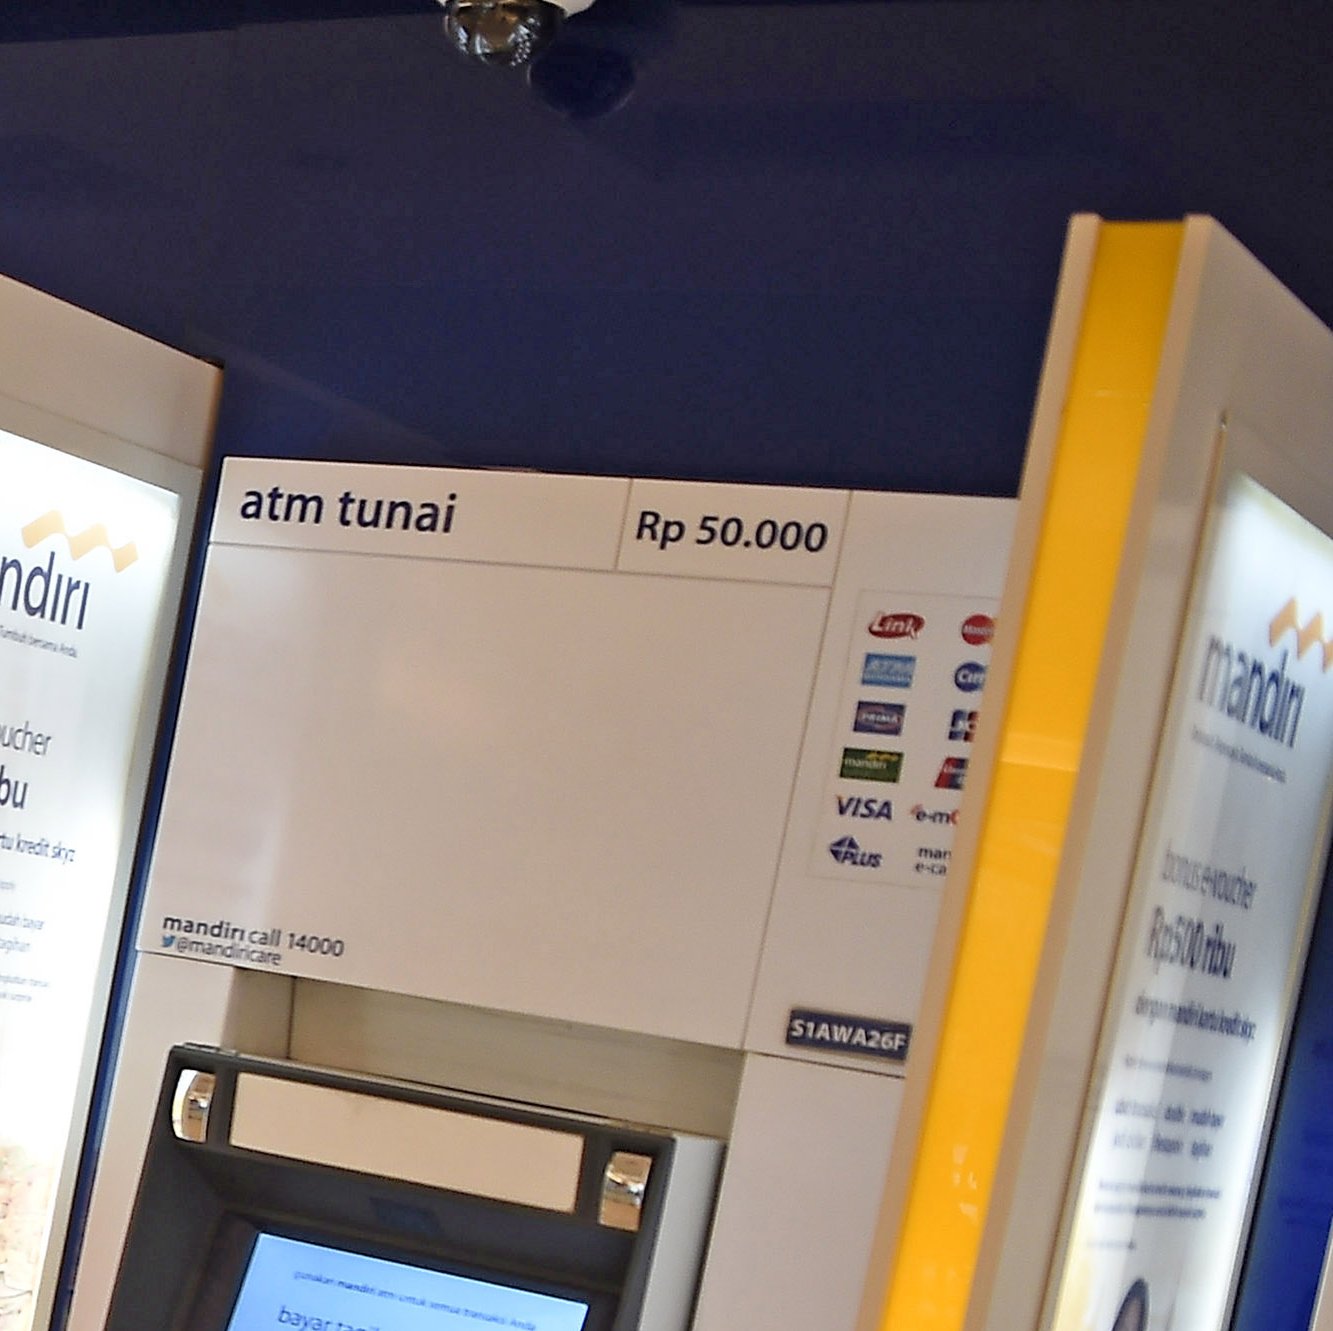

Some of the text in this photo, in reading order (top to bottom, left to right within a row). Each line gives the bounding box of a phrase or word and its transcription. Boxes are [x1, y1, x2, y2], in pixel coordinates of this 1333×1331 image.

[239, 484, 458, 534] atm tunai
[635, 510, 829, 554] Rp 50.000
[869, 611, 921, 639] Link
[1199, 634, 1307, 750] mandiri
[837, 797, 892, 821] VISA
[842, 847, 883, 868] PLUS
[162, 914, 345, 960] mandiri call 14000
[176, 936, 281, 968] @mandiricare
[791, 1018, 907, 1052] S1AWA26F
[278, 1305, 331, 1331] bayar
